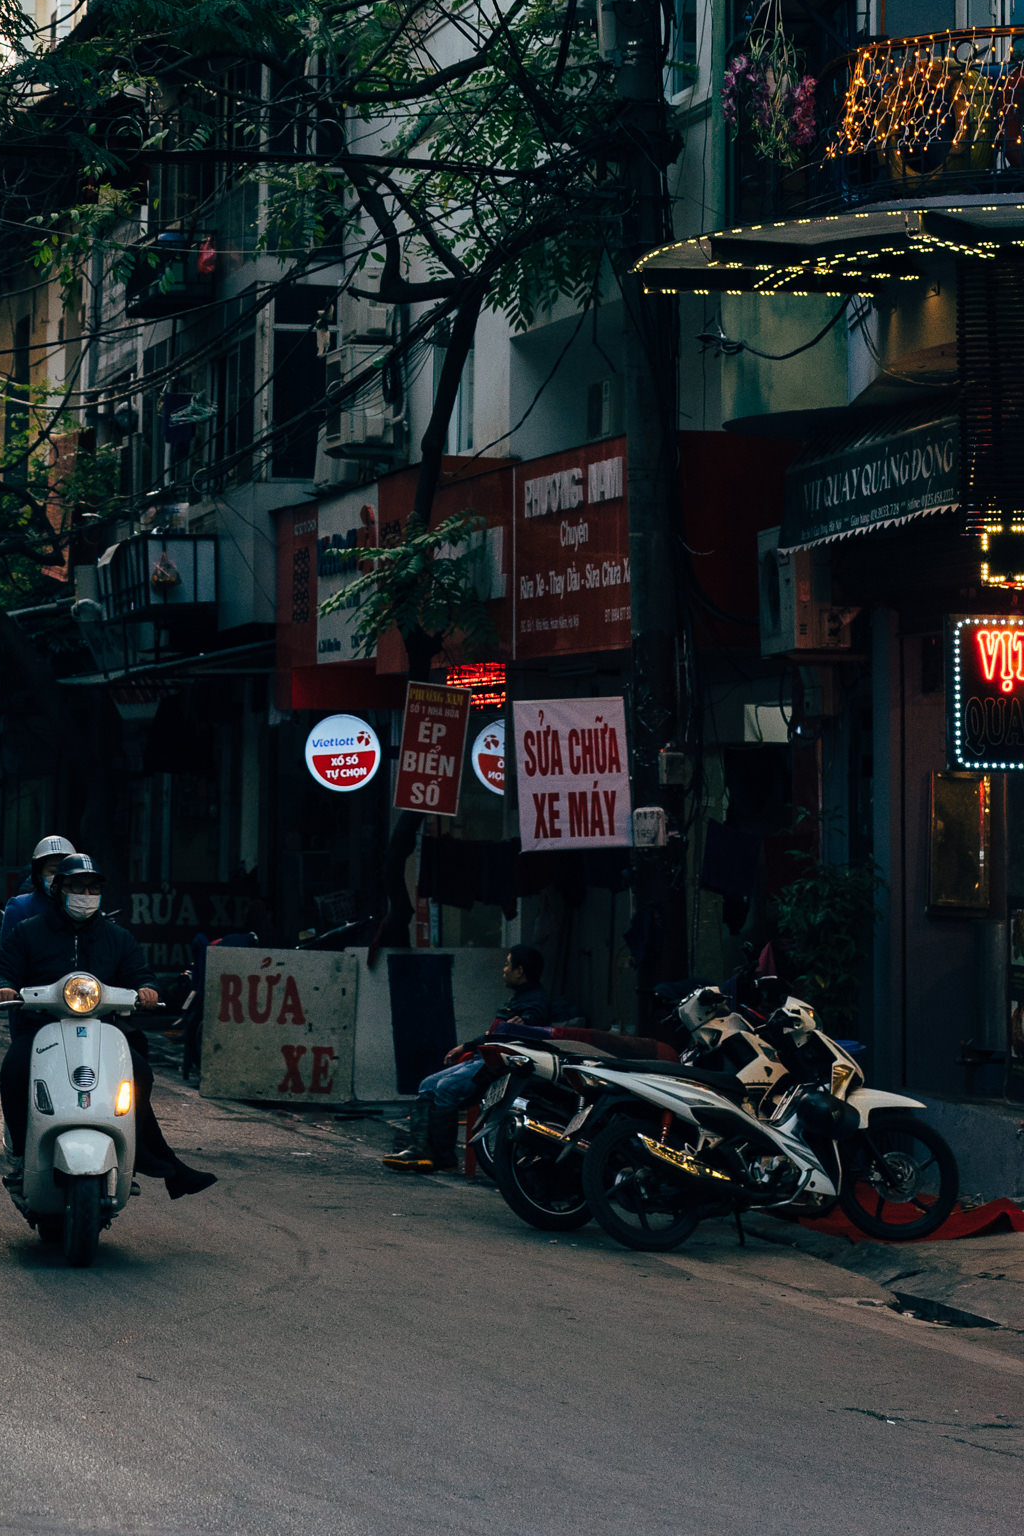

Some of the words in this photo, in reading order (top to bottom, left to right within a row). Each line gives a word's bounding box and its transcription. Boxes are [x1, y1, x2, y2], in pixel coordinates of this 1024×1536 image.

[588, 456, 623, 504] NAM
[823, 466, 861, 508] QUAY
[560, 517, 589, 552] Chuyên
[535, 572, 545, 598] Xe
[548, 569, 565, 600] Thay
[312, 737, 355, 749] Vietlott
[418, 717, 447, 744] ÉP
[523, 709, 564, 777] SỬA
[568, 715, 621, 776] CHỮA
[325, 768, 339, 780] TỰ
[340, 766, 367, 779] CHỌN
[346, 753, 359, 766] SỐ
[402, 745, 456, 778] BIỂN
[410, 778, 443, 806] SỐ
[532, 792, 562, 839] XE
[568, 780, 616, 838] MÁY
[130, 881, 200, 927] RỬA
[218, 957, 306, 1025] RỬA
[278, 1044, 335, 1094] XE
